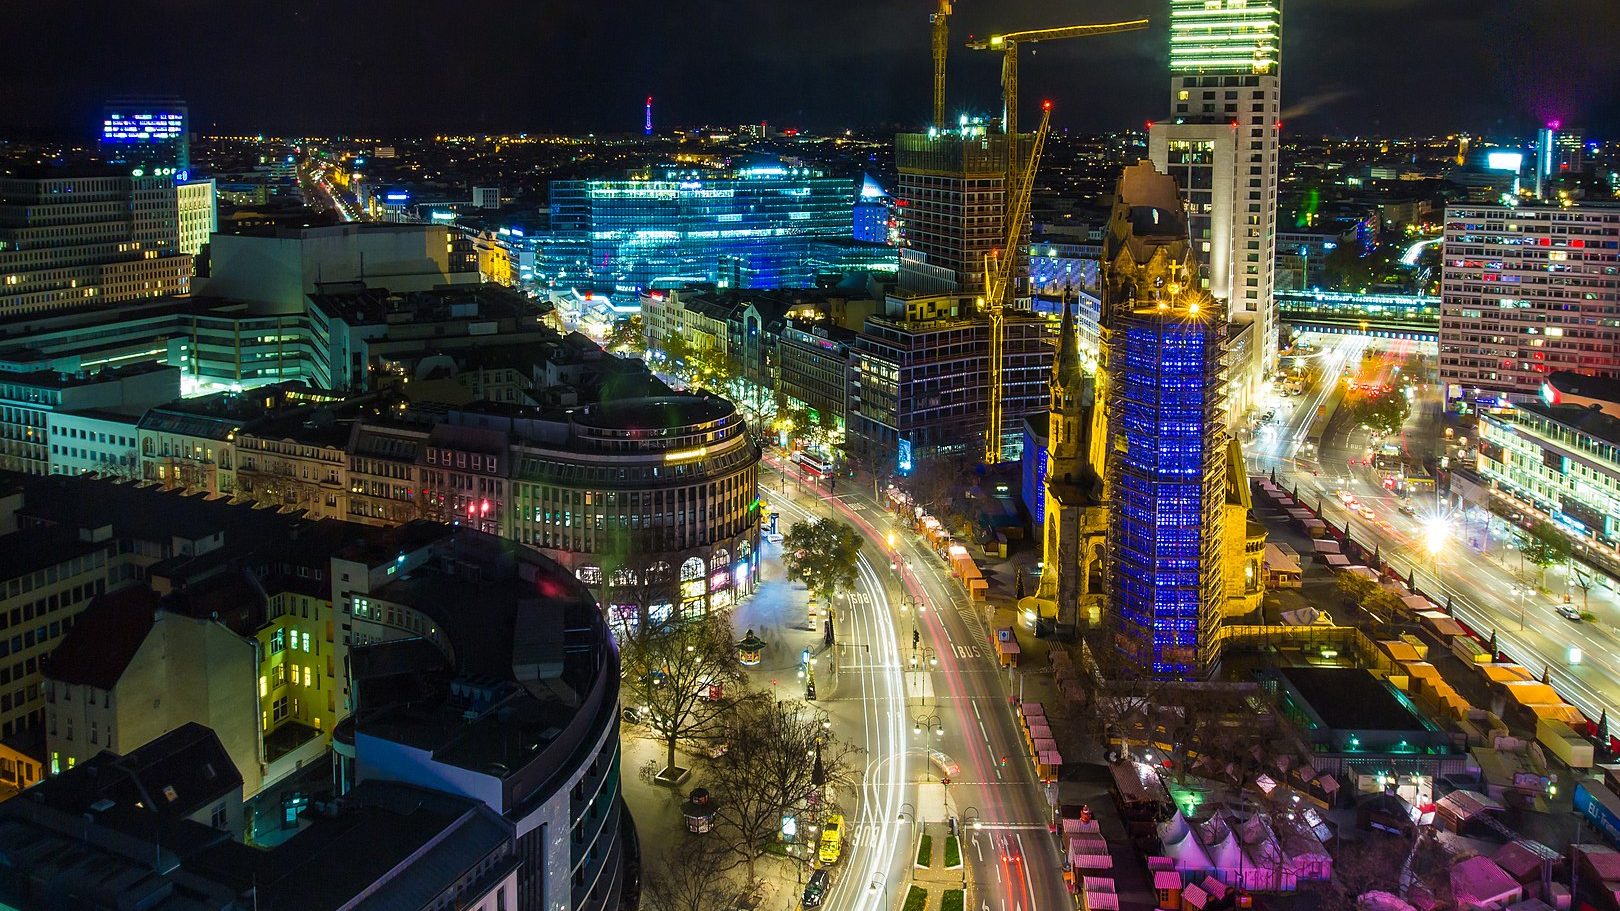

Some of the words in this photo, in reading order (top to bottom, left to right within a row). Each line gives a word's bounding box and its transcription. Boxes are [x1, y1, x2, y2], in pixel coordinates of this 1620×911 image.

[852, 592, 870, 604] BUS
[957, 645, 981, 659] BUS
[852, 825, 880, 848] BUS
